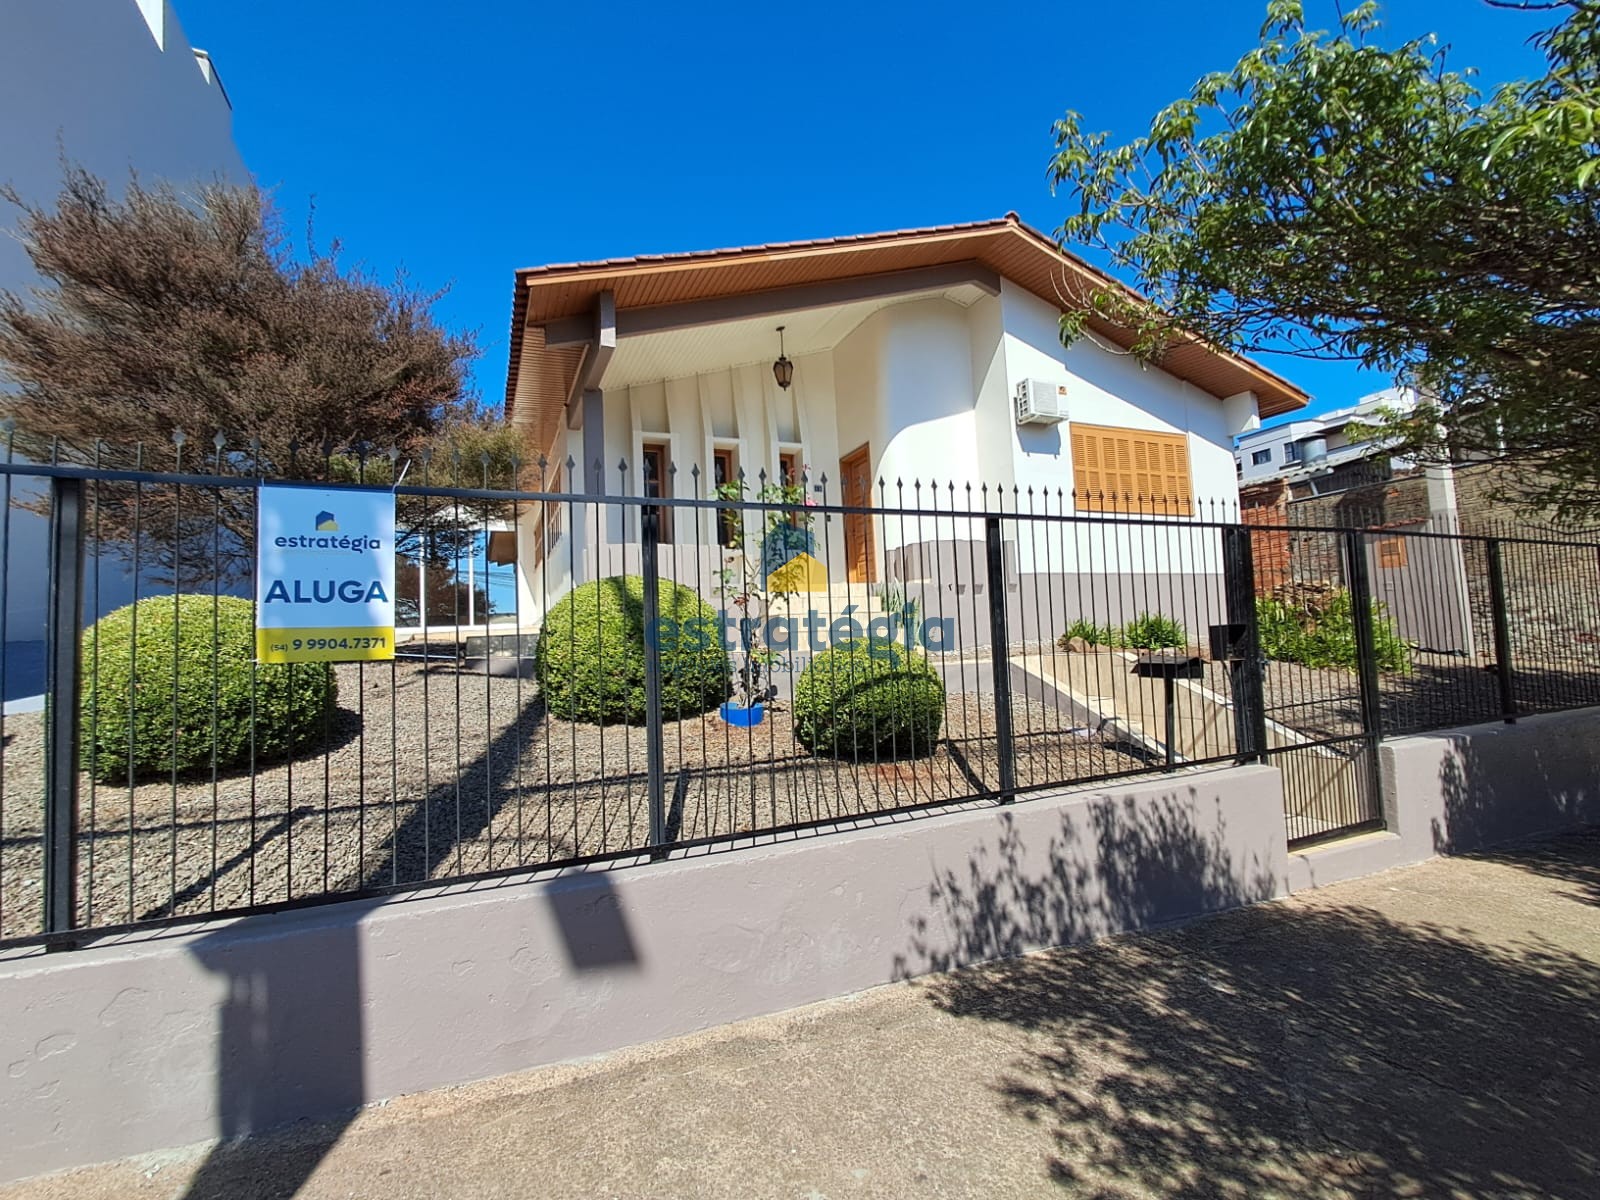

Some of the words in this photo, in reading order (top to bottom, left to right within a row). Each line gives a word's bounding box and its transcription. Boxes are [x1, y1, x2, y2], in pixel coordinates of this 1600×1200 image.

[275, 535, 381, 554] estratégia
[264, 579, 389, 604] ALUGA
[270, 644, 289, 652] (54)
[292, 639, 303, 650] 9
[306, 638, 386, 650] 9904.7371
